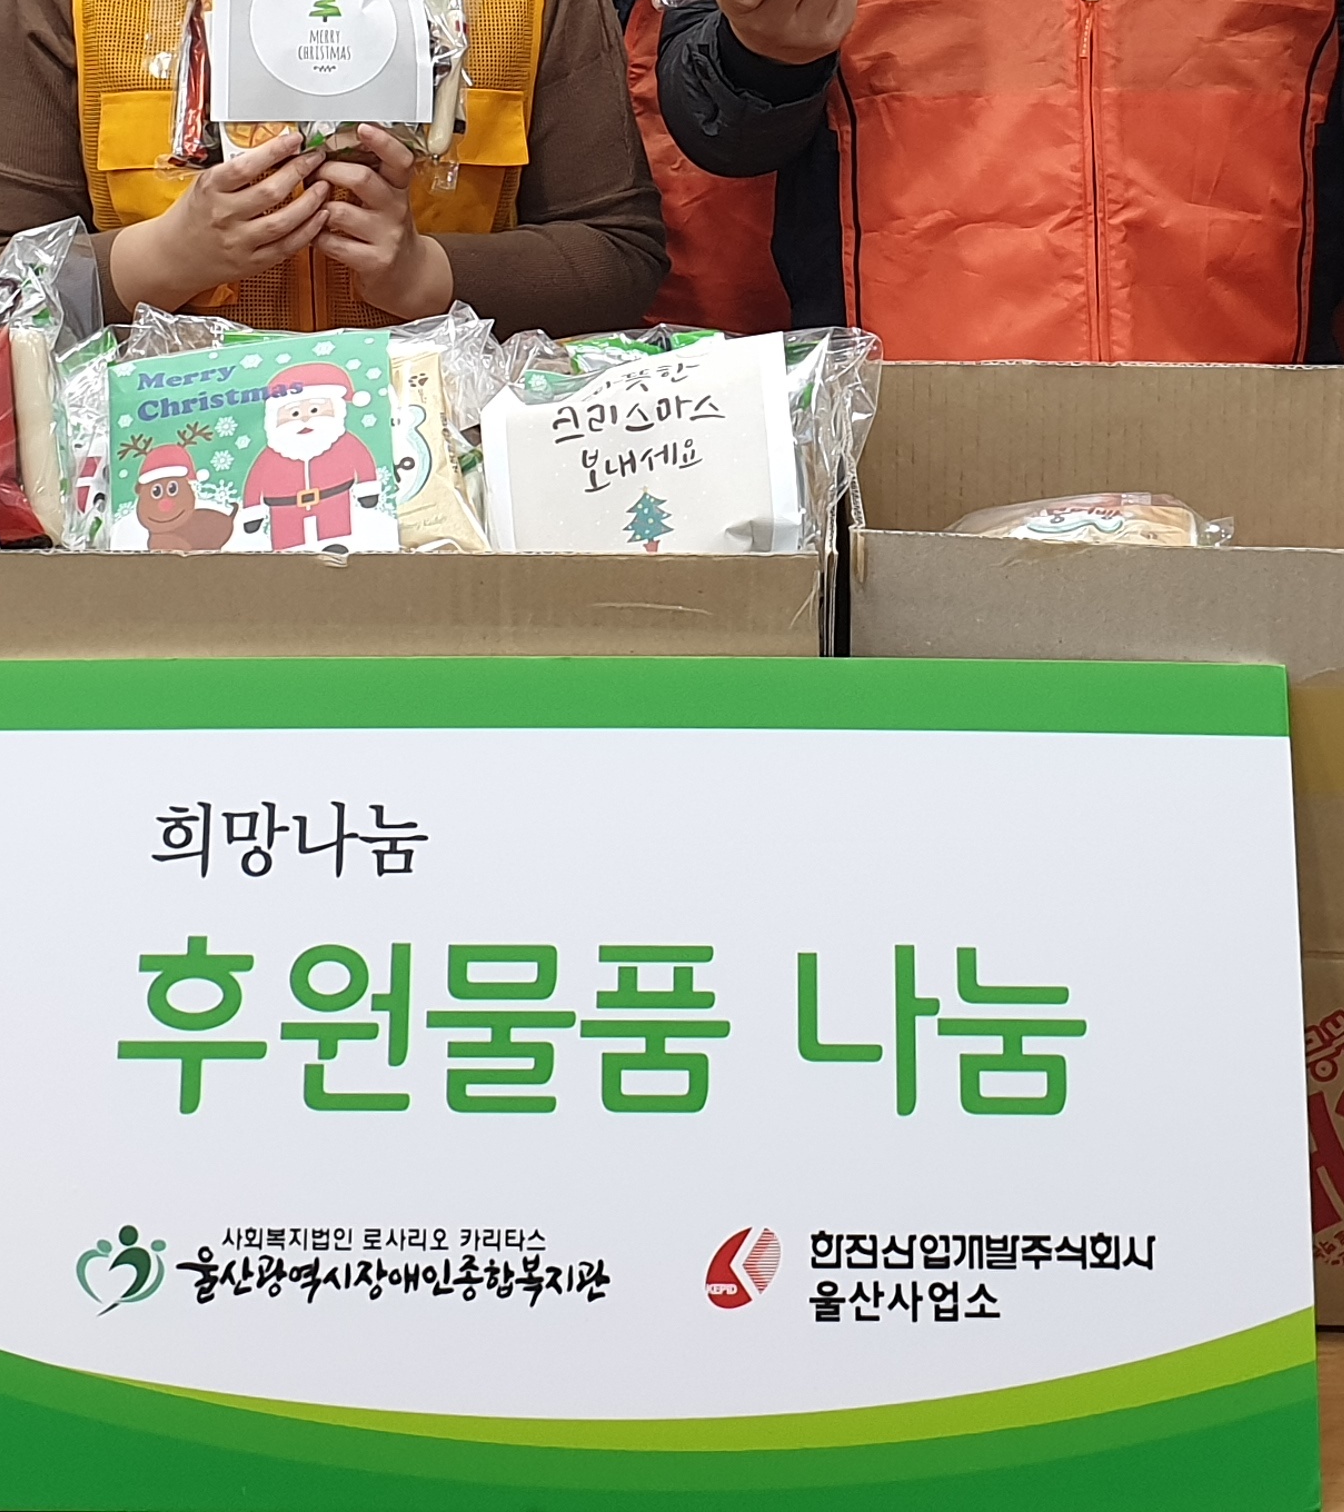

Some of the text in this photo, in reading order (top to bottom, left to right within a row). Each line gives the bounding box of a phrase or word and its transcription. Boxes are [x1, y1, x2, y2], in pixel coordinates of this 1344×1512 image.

[297, 44, 352, 62] CHRISTMAS
[309, 29, 340, 44] MERRY
[136, 365, 236, 391] Merry
[136, 381, 305, 422] Christmas
[552, 394, 727, 445] 크리스마스
[581, 438, 704, 493] 보내세요
[149, 801, 431, 880] 희망나눔
[116, 934, 1087, 1116] 후원물품 나눔
[221, 1227, 547, 1252] 사회복지법인 로사리오 카리타스
[176, 1245, 611, 1307] 울산광역시장애인종합복지관
[809, 1280, 1001, 1322] 울산사업소
